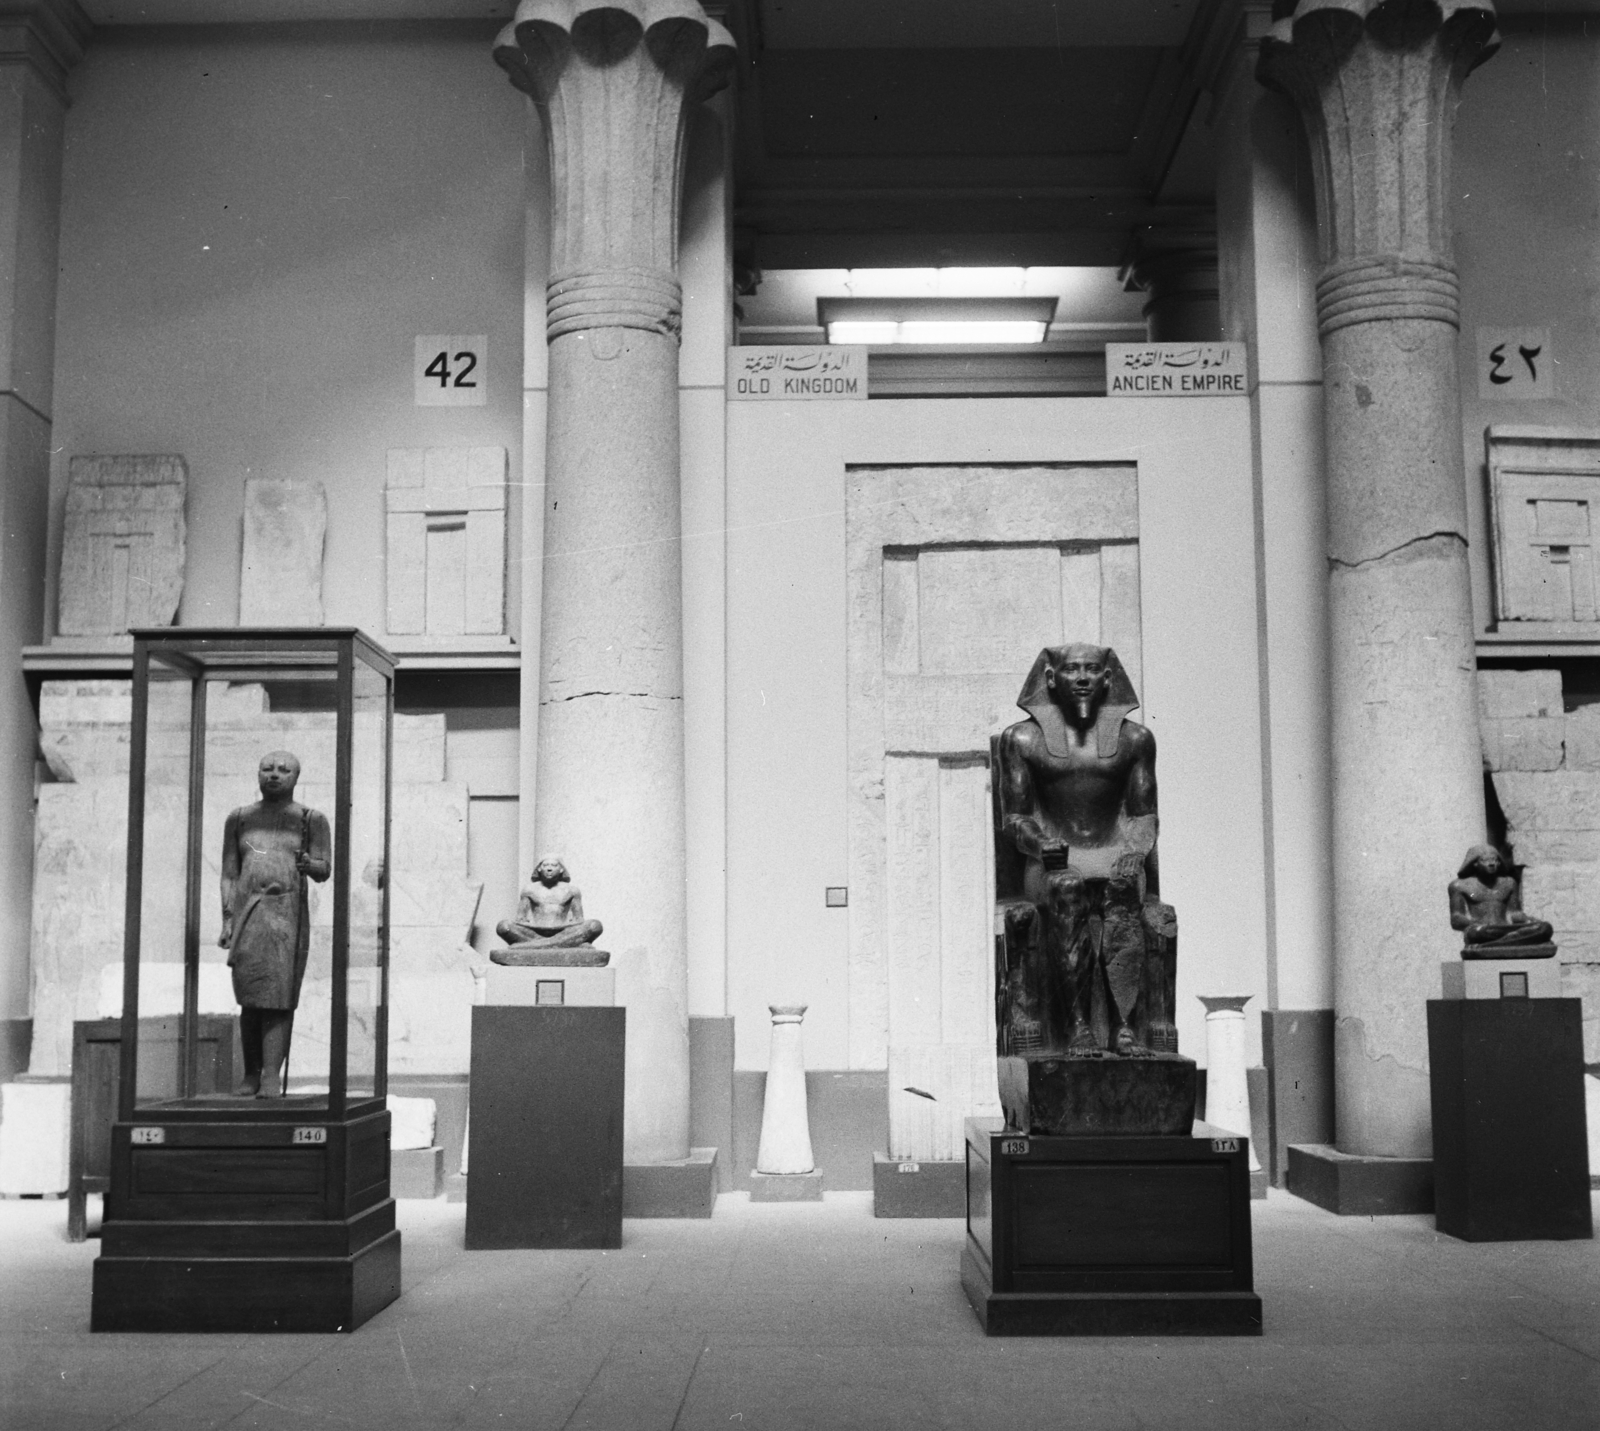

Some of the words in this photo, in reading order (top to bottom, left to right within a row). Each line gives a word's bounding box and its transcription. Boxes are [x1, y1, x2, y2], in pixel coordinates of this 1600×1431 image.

[424, 351, 477, 388] 42
[1489, 343, 1542, 385] ٤٢
[737, 378, 770, 394] OLD
[784, 378, 858, 394] KINGDOM
[1112, 374, 1173, 391] ANCIEN
[1181, 374, 1245, 391] EMPIRE
[299, 1130, 322, 1141] 140
[1007, 1141, 1025, 1154] 138
